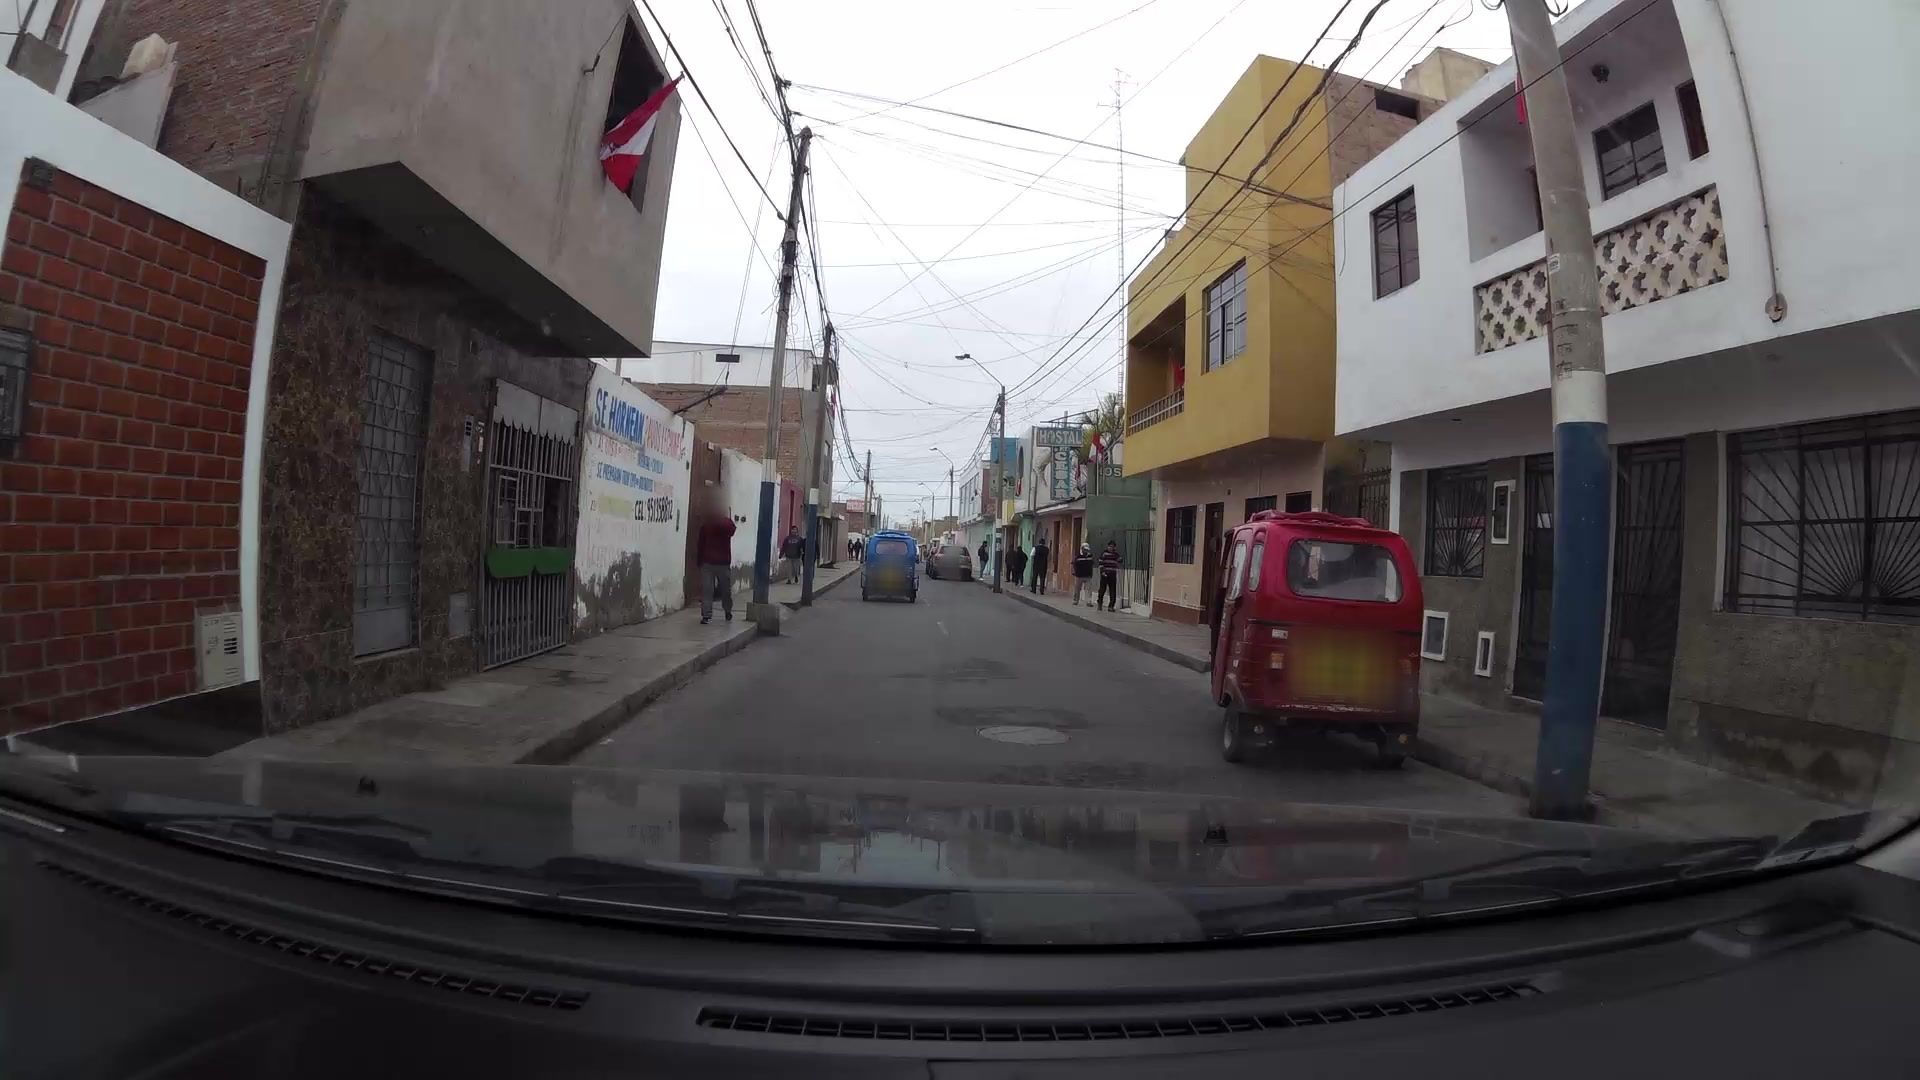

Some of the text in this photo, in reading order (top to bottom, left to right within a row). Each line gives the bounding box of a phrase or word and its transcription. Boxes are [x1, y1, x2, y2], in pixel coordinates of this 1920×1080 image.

[595, 388, 609, 429] SE
[608, 395, 645, 445] HORNEAN
[1039, 428, 1082, 445] HOSTAL
